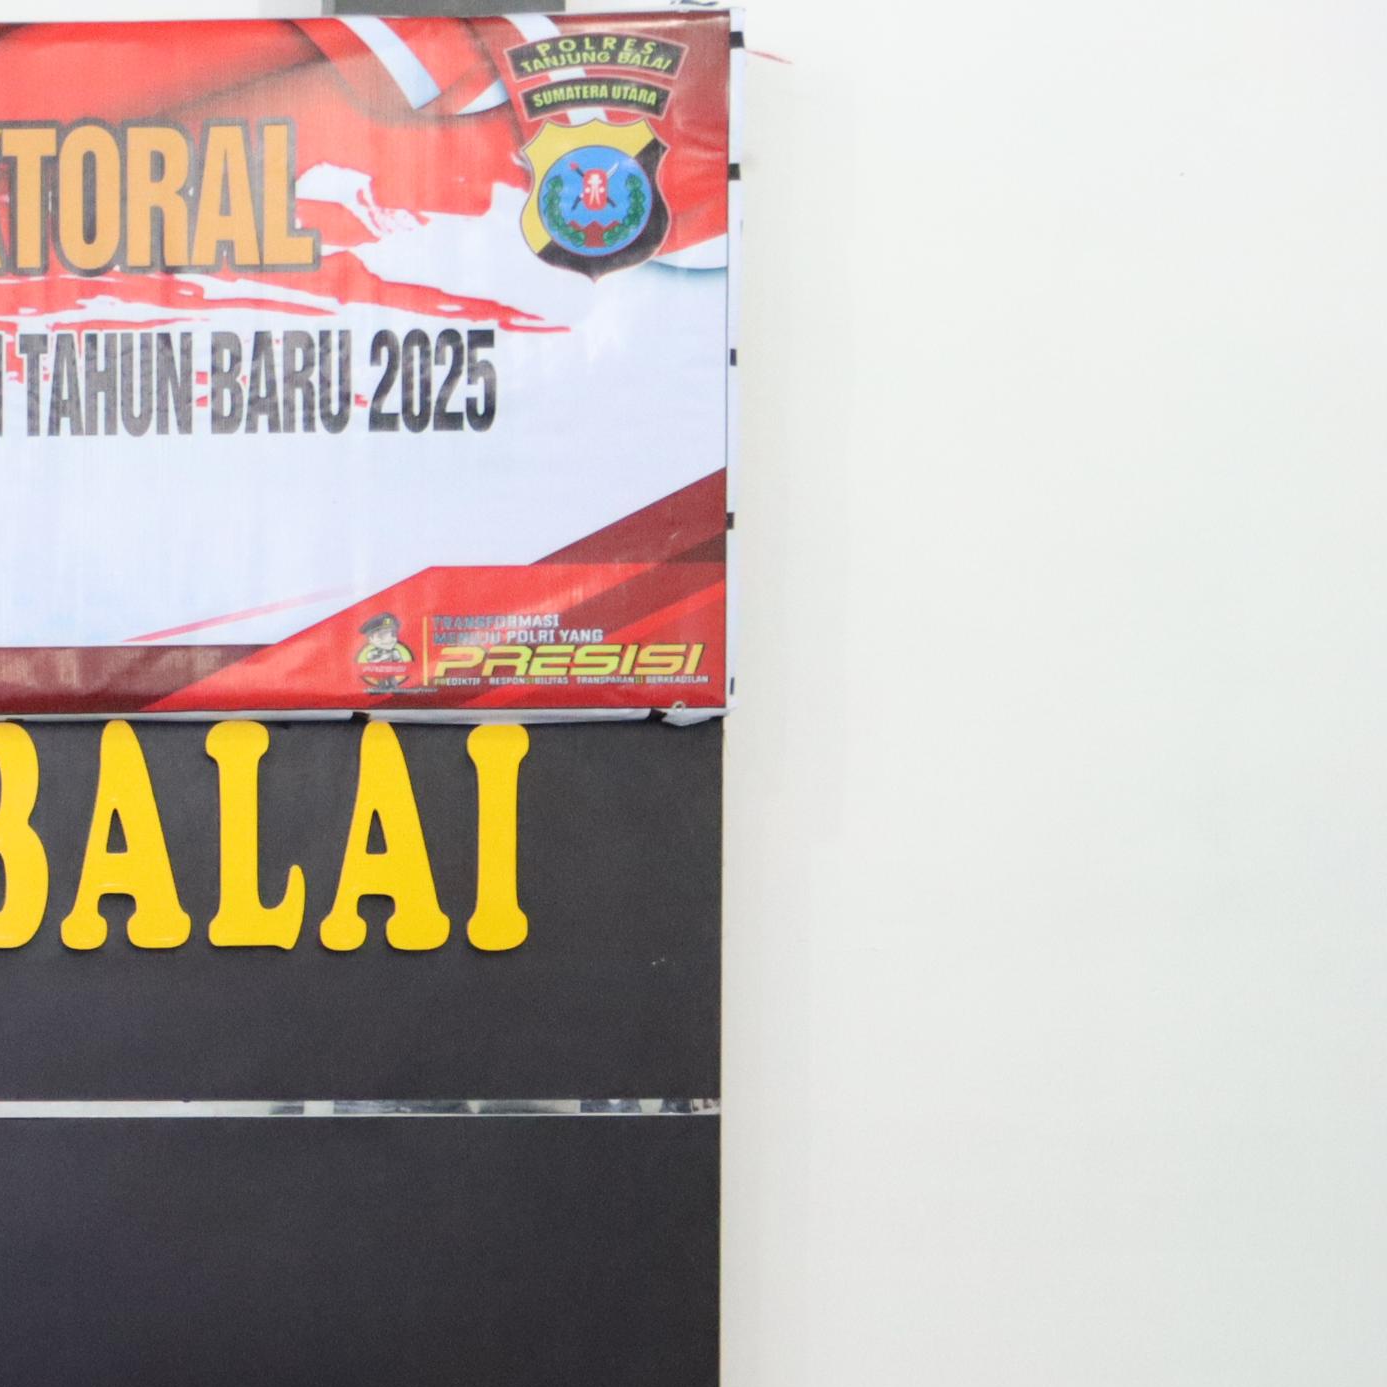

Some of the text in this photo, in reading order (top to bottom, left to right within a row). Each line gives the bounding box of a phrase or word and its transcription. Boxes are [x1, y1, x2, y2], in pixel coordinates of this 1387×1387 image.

[536, 36, 657, 55] POLRES
[521, 51, 673, 73] TANJUNG BALAI
[533, 85, 657, 108] SUMATERA UTARA
[17, 331, 194, 437] TAHUN
[210, 330, 351, 434] BARU
[368, 328, 497, 433] 2025
[432, 614, 560, 629] TRANSFORMASI
[506, 629, 556, 643] POLRI
[559, 628, 604, 643] YANG
[434, 643, 704, 677] PRESISI
